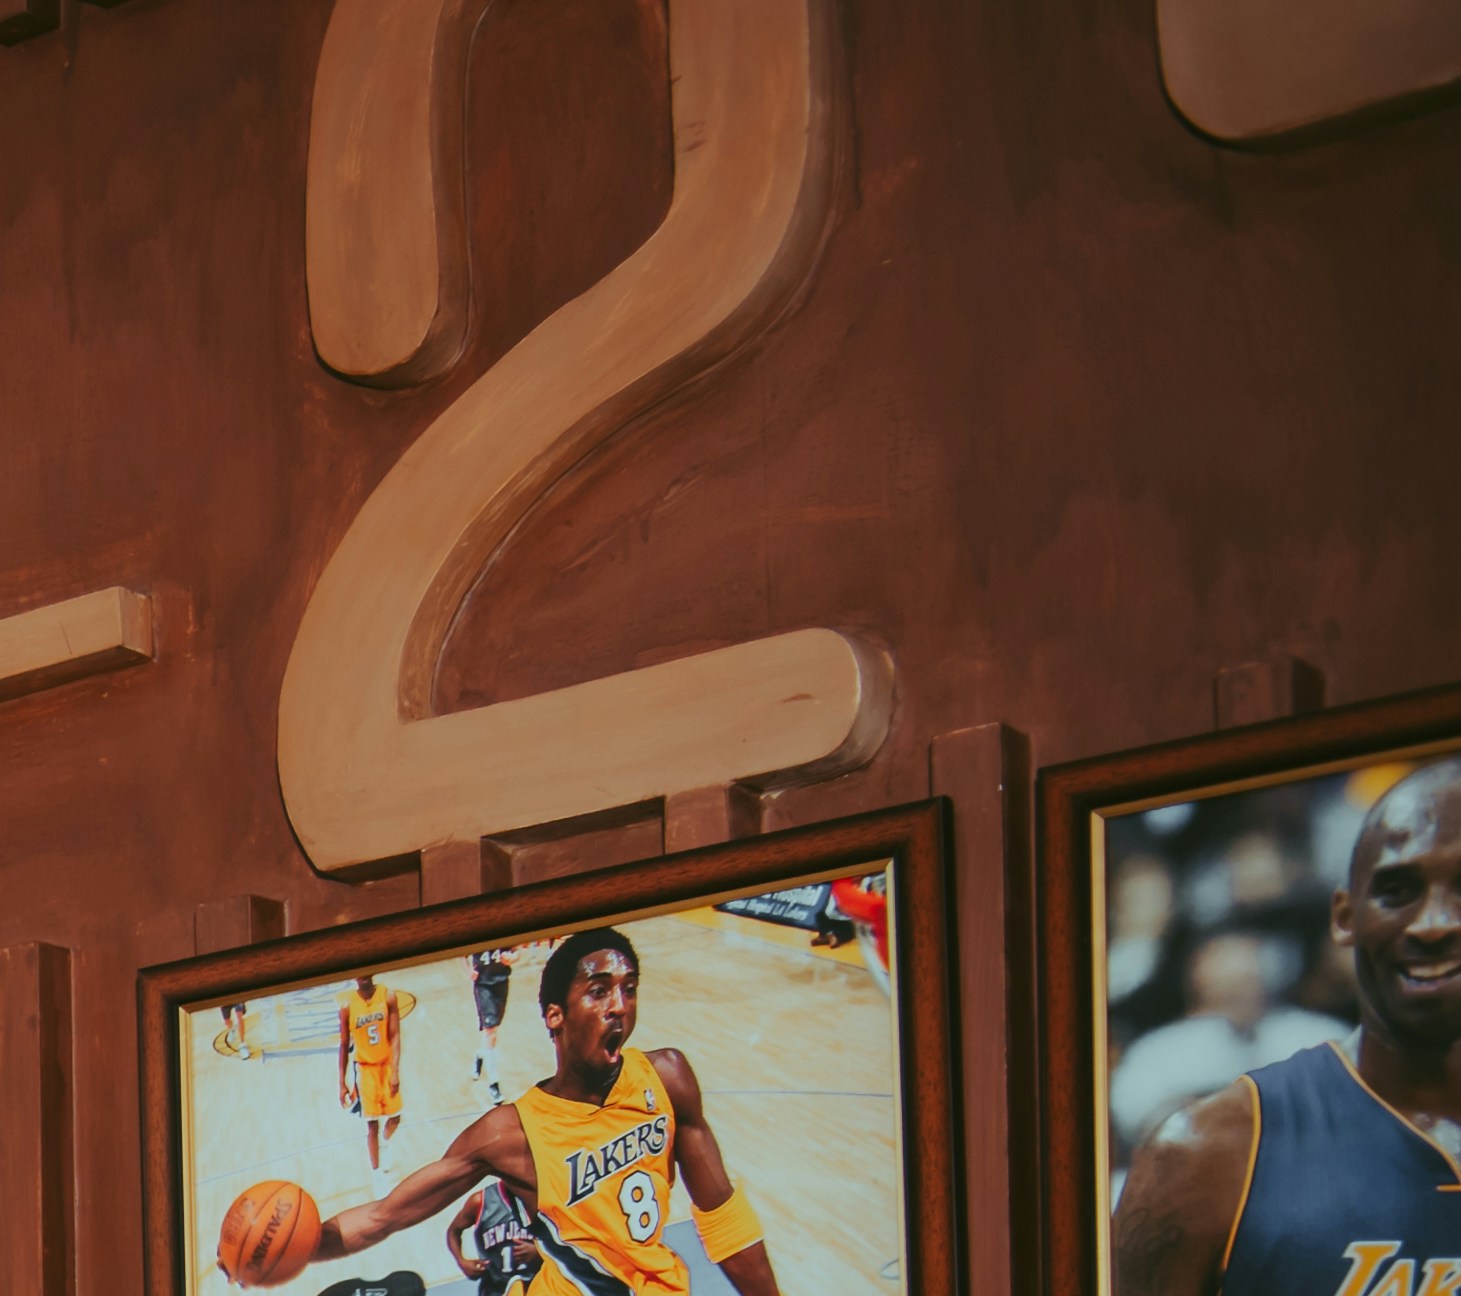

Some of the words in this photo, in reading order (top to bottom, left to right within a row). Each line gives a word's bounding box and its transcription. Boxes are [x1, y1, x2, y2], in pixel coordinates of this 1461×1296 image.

[367, 1024, 381, 1046] 5
[565, 1113, 669, 1207] LAKERS
[617, 1169, 661, 1244] 8
